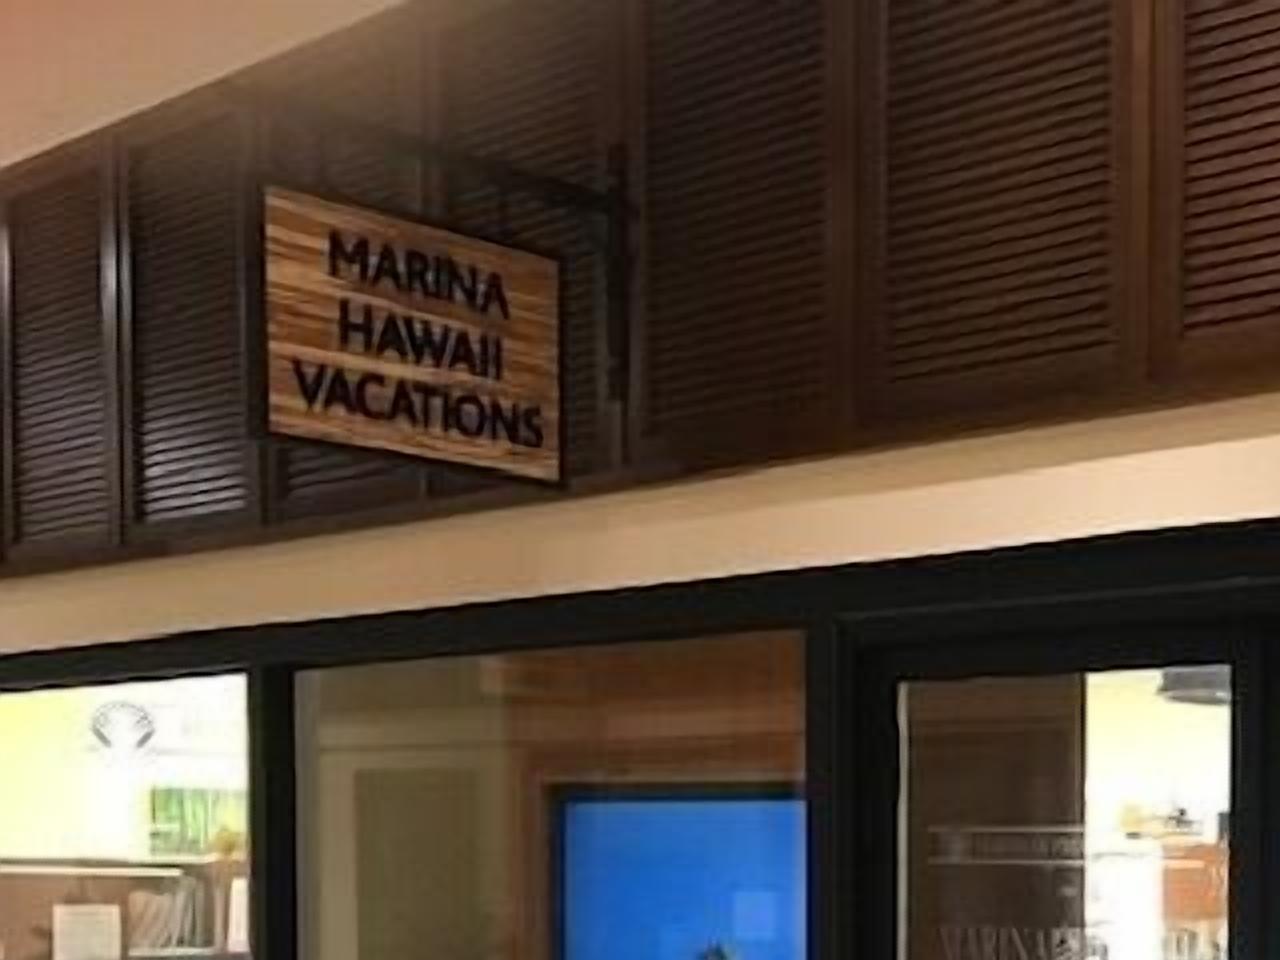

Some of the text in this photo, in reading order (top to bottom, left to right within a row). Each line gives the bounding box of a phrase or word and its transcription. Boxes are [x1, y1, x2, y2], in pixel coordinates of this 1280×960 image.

[327, 228, 510, 321] MARINA
[339, 298, 504, 382] HAWAII
[292, 358, 545, 449] VACATIONS
